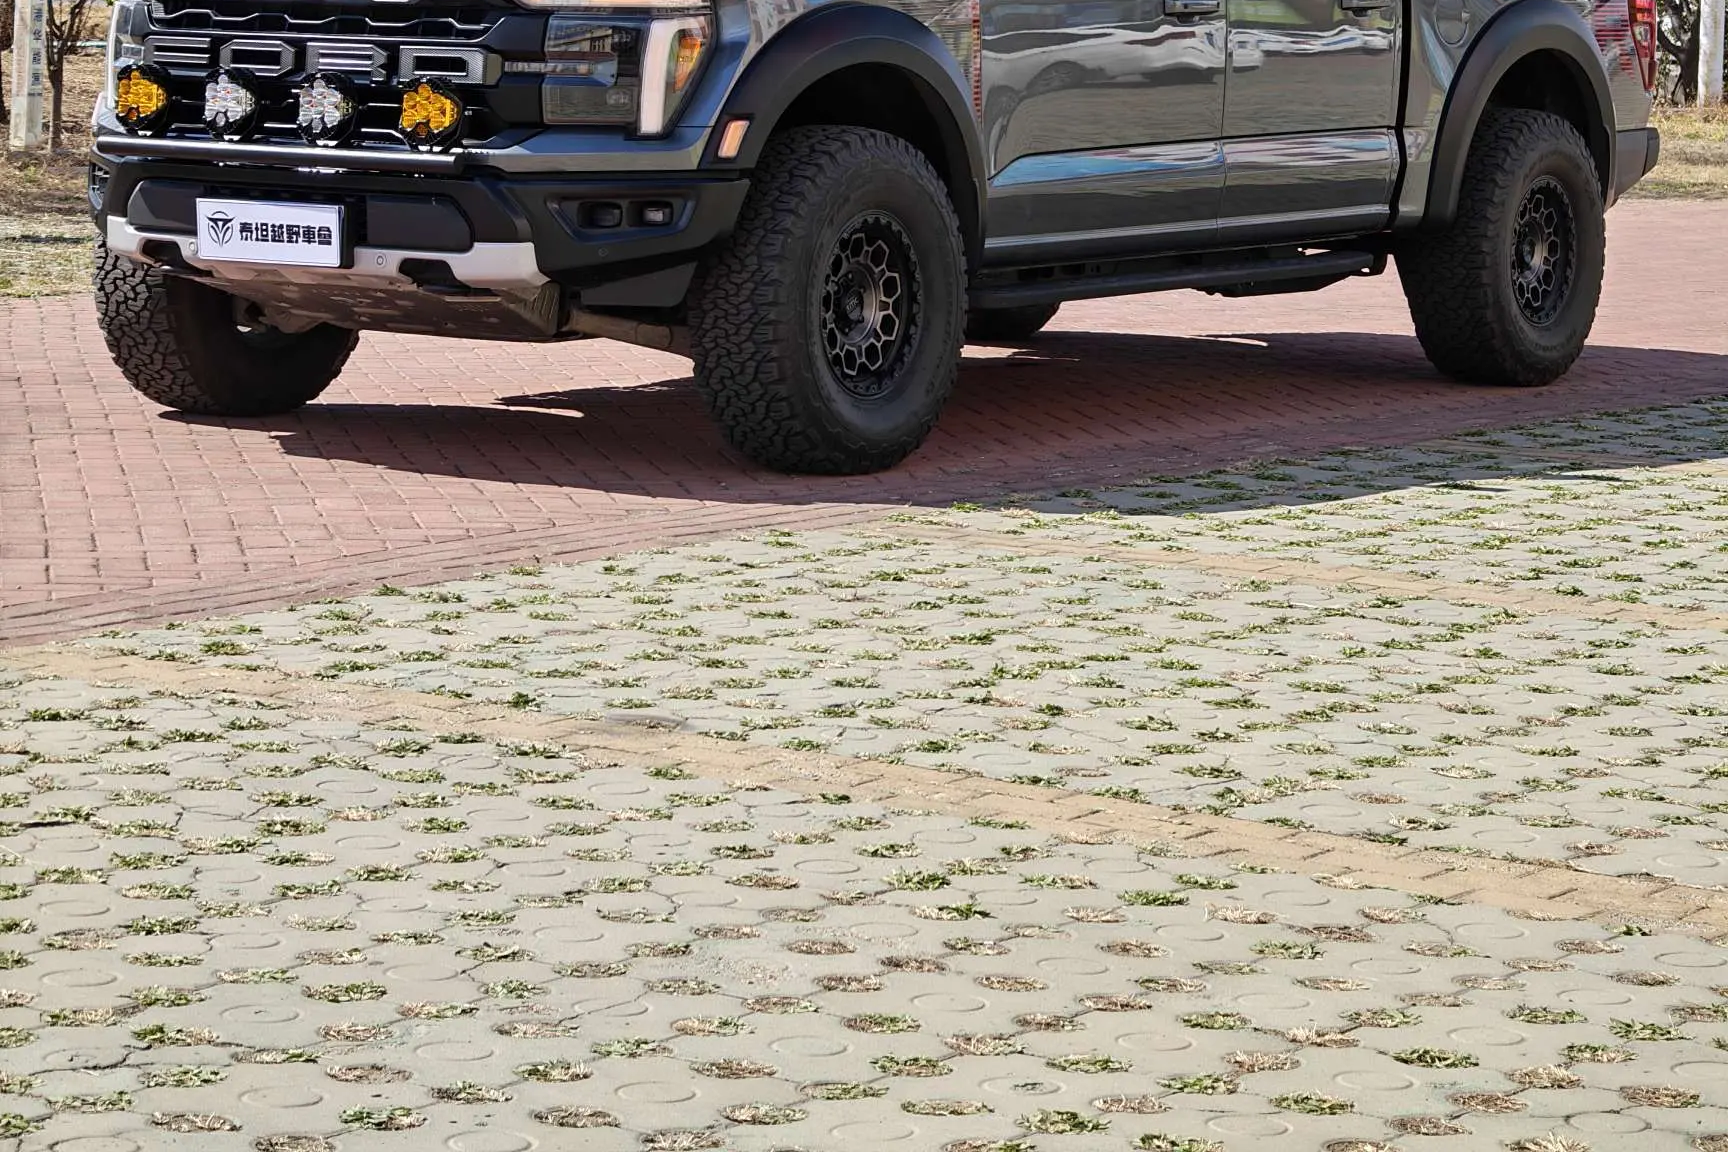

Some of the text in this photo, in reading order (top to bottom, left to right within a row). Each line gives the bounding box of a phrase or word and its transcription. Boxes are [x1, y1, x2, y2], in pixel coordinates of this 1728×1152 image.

[144, 34, 502, 86] FORD
[239, 222, 332, 246] 泰坦越野車會
